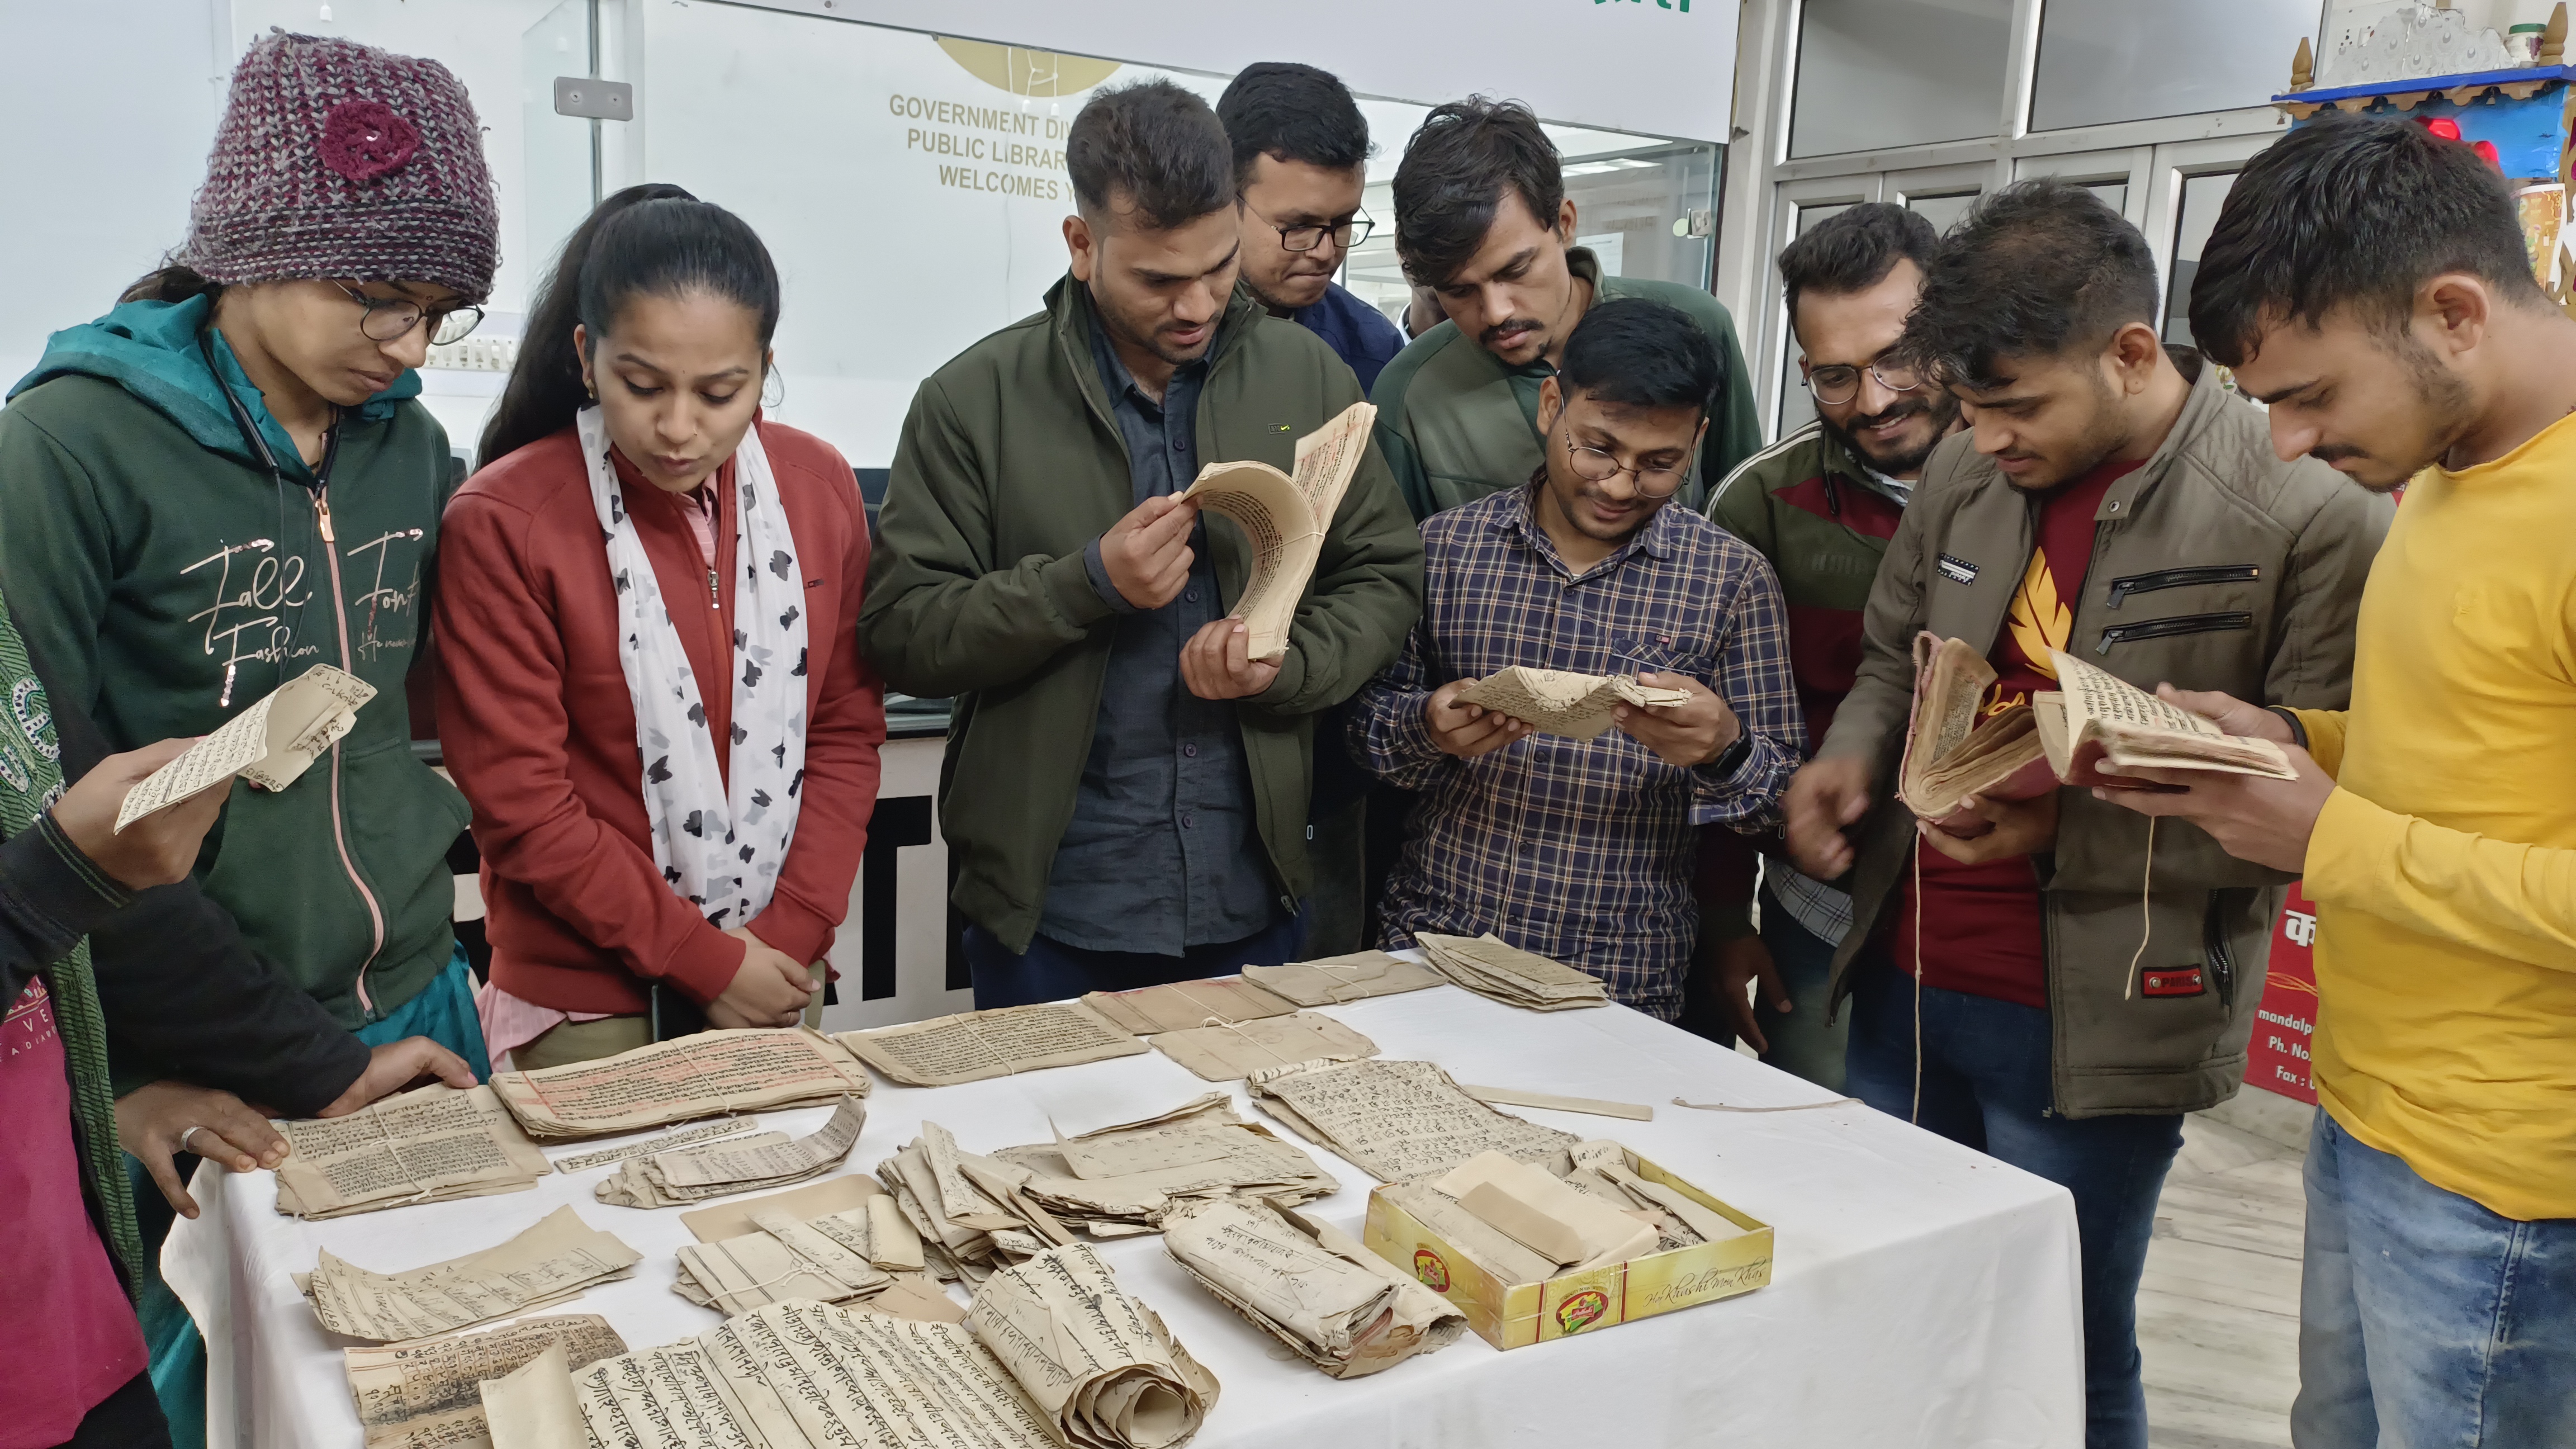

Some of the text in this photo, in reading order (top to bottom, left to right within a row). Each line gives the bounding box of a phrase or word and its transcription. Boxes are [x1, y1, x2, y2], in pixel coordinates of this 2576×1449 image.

[889, 94, 1040, 136] GOVERNMENT
[907, 128, 1067, 171] PUBLIC LIBRAR
[939, 164, 1058, 201] WELCOMES
[2267, 1035, 2288, 1054] Ph.
[2276, 1064, 2298, 1085] Fax
[1661, 1267, 1718, 1304] Khushi
[1735, 1256, 1767, 1286] Khas
